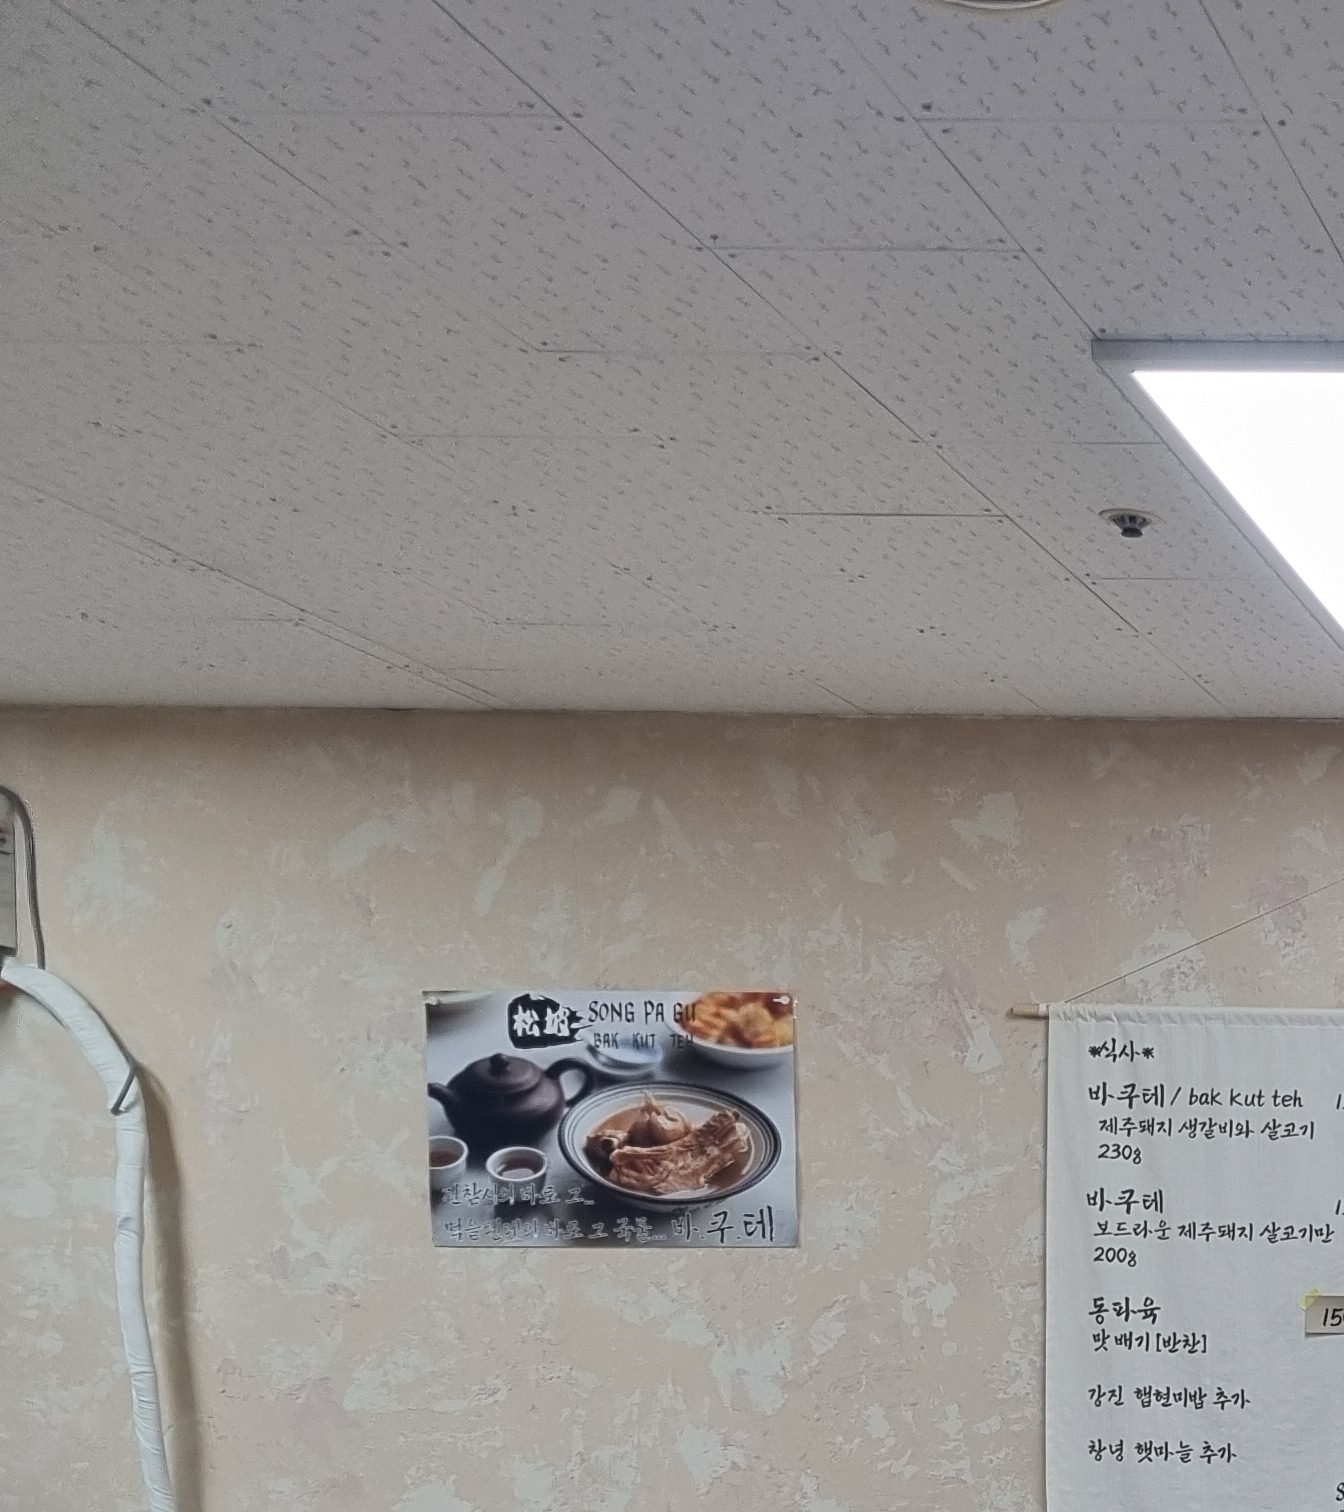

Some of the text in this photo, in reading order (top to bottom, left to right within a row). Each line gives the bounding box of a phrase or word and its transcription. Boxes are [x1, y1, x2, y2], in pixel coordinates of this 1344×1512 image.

[588, 1000, 696, 1025] SONG PA GU
[594, 1033, 694, 1049] BAK KUT TEH
[1088, 1082, 1165, 1109] 바쿠테
[1188, 1087, 1223, 1107] bak
[1229, 1088, 1266, 1107] kut
[1272, 1089, 1304, 1108] teh
[1098, 1116, 1316, 1141] 제주돼지 생갈비와 살고기
[1097, 1144, 1143, 1165] 230g
[1087, 1188, 1165, 1214] 바쿠테
[588, 1222, 609, 1239] 그
[1093, 1220, 1335, 1244] 보드라운 제주돼지 살고기만
[1093, 1247, 1138, 1267] 200g
[1088, 1297, 1161, 1325] 동파육
[1088, 1385, 1125, 1408] 강진
[1134, 1385, 1207, 1411] 햅현미밥
[1213, 1387, 1251, 1410] 추가
[1088, 1439, 1125, 1463] 창녕
[1135, 1440, 1194, 1463] 햇마늘
[1199, 1441, 1238, 1464] 추가
